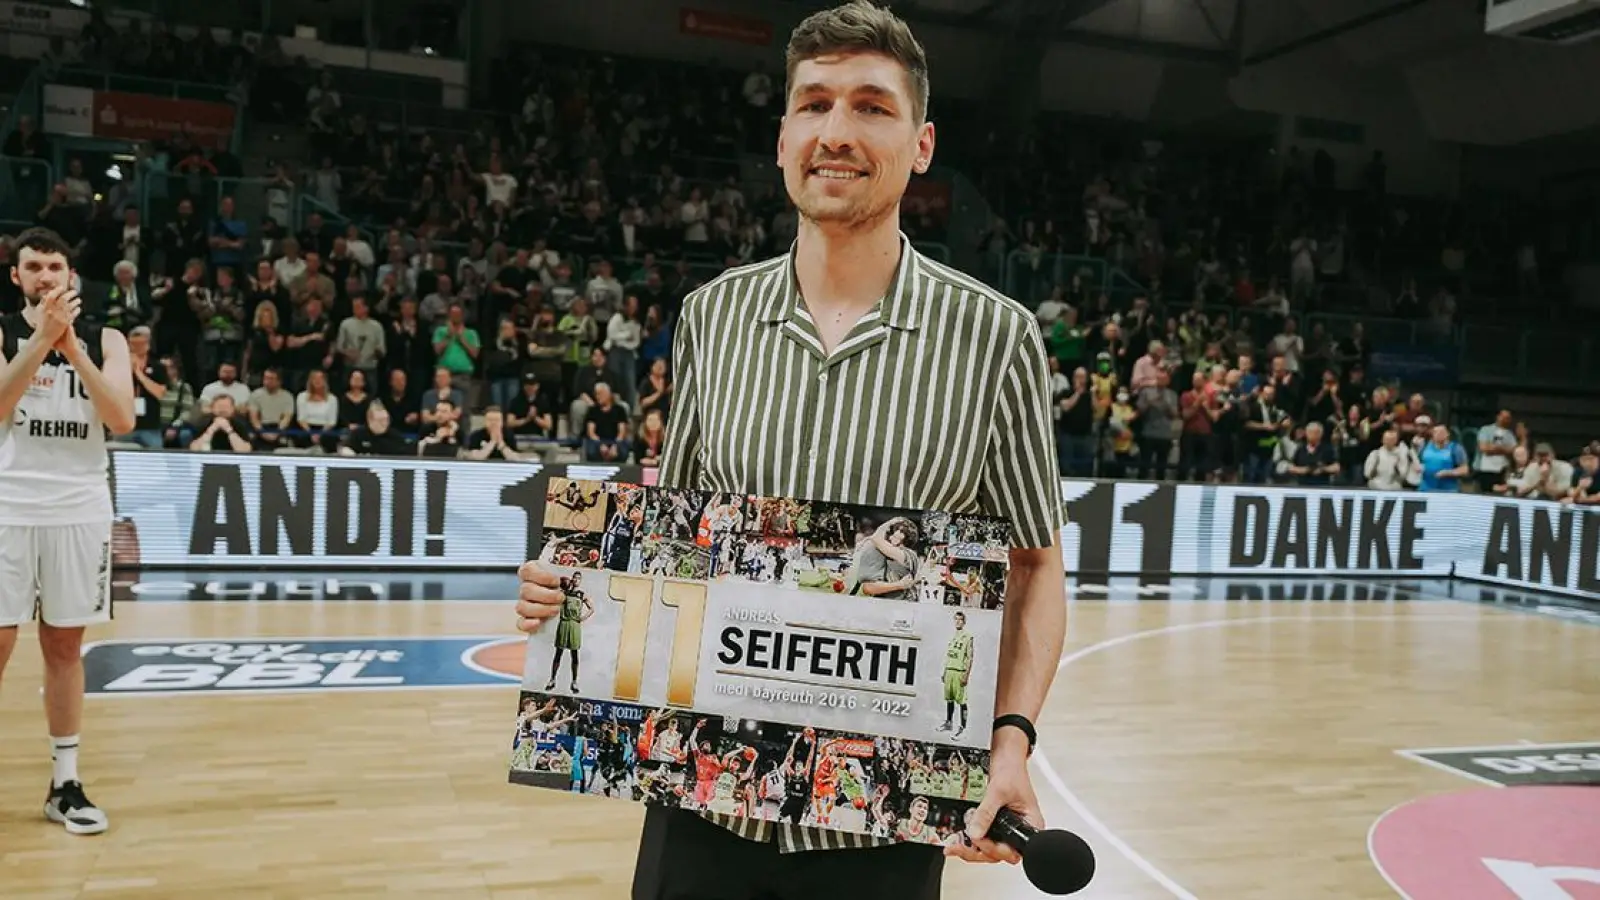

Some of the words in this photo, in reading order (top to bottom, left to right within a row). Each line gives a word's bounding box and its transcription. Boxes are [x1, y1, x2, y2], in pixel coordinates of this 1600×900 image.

[29, 419, 89, 440] REHAU
[188, 463, 449, 557] ANDI!
[1229, 494, 1428, 570] DANKE
[722, 605, 782, 625] ANDREAS
[607, 573, 708, 709] 11
[716, 626, 918, 686] SEIFERTH
[103, 663, 404, 690] BBL
[713, 681, 748, 698] medi
[752, 684, 815, 706] bayreuth
[818, 691, 858, 711] 2016
[870, 699, 911, 718] 2022
